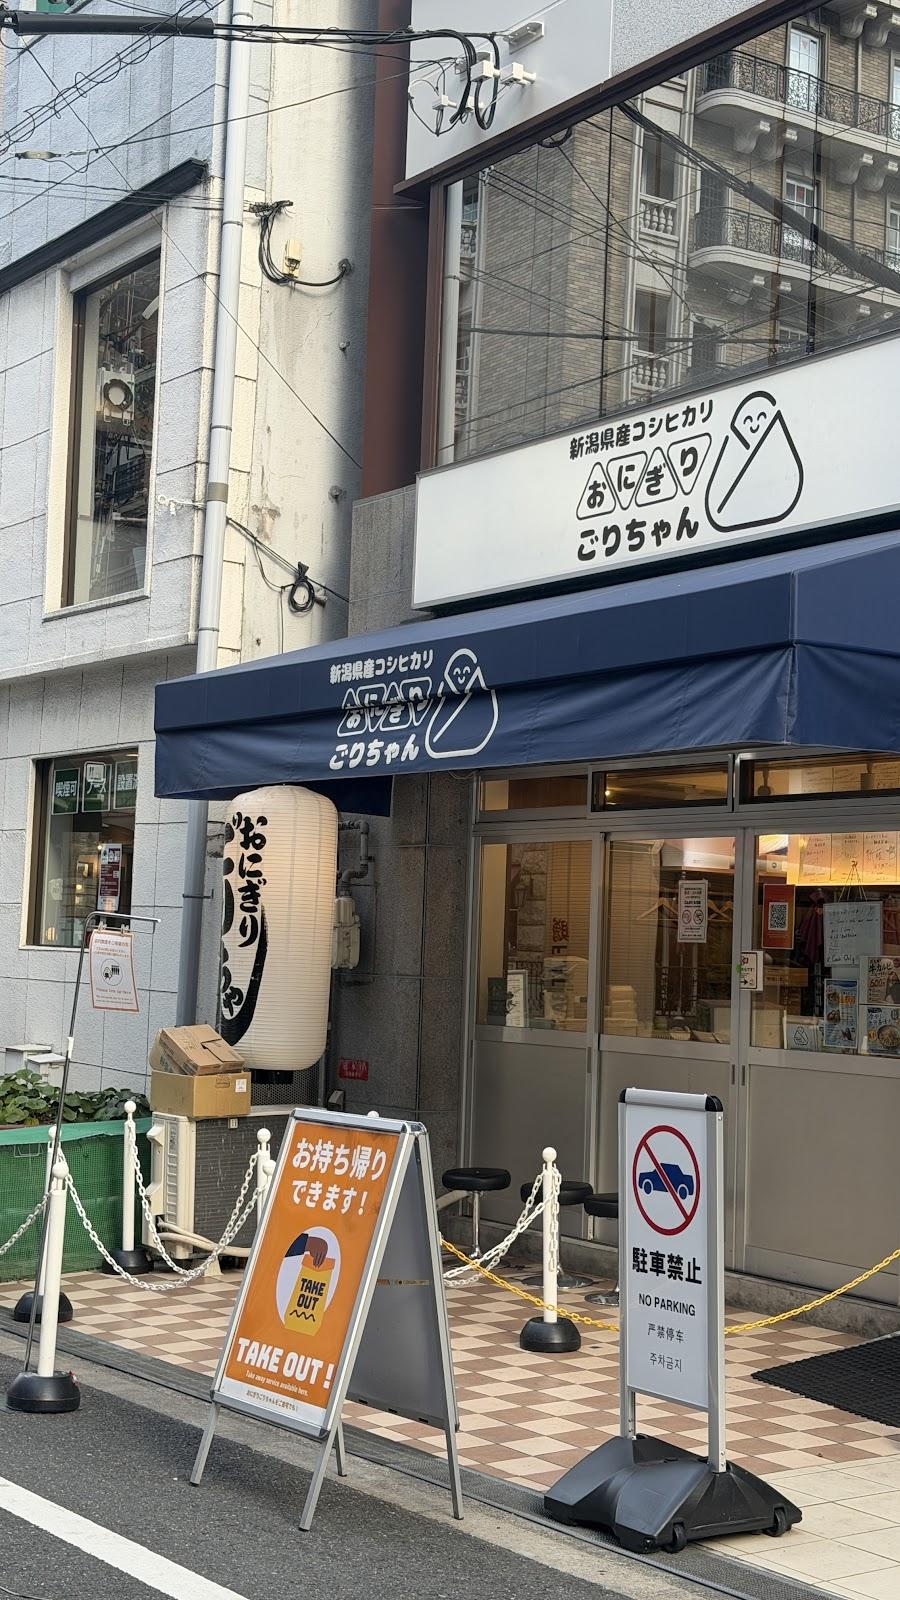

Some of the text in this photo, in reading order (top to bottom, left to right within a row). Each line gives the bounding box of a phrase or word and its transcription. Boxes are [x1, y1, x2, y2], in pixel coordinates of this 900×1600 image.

[569, 399, 714, 461] 新潟県産コシヒカリ
[585, 445, 699, 510] おにぎり
[577, 506, 700, 562] ごりちゃん
[329, 649, 434, 685] 新潟県産コシヒカリ
[329, 733, 420, 771] ごりちゃん
[237, 815, 268, 948] おにぎり
[291, 1138, 387, 1182] お持ち帰り
[291, 1179, 368, 1216] できます！
[632, 1246, 703, 1285] 駐車禁止
[297, 1294, 320, 1311] OUT
[300, 1277, 326, 1297] TAKE
[638, 1292, 696, 1317] NO PARKING
[647, 1322, 685, 1343] 严禁停车
[236, 1337, 284, 1374] TAKE
[649, 1352, 683, 1373] 주차금지
